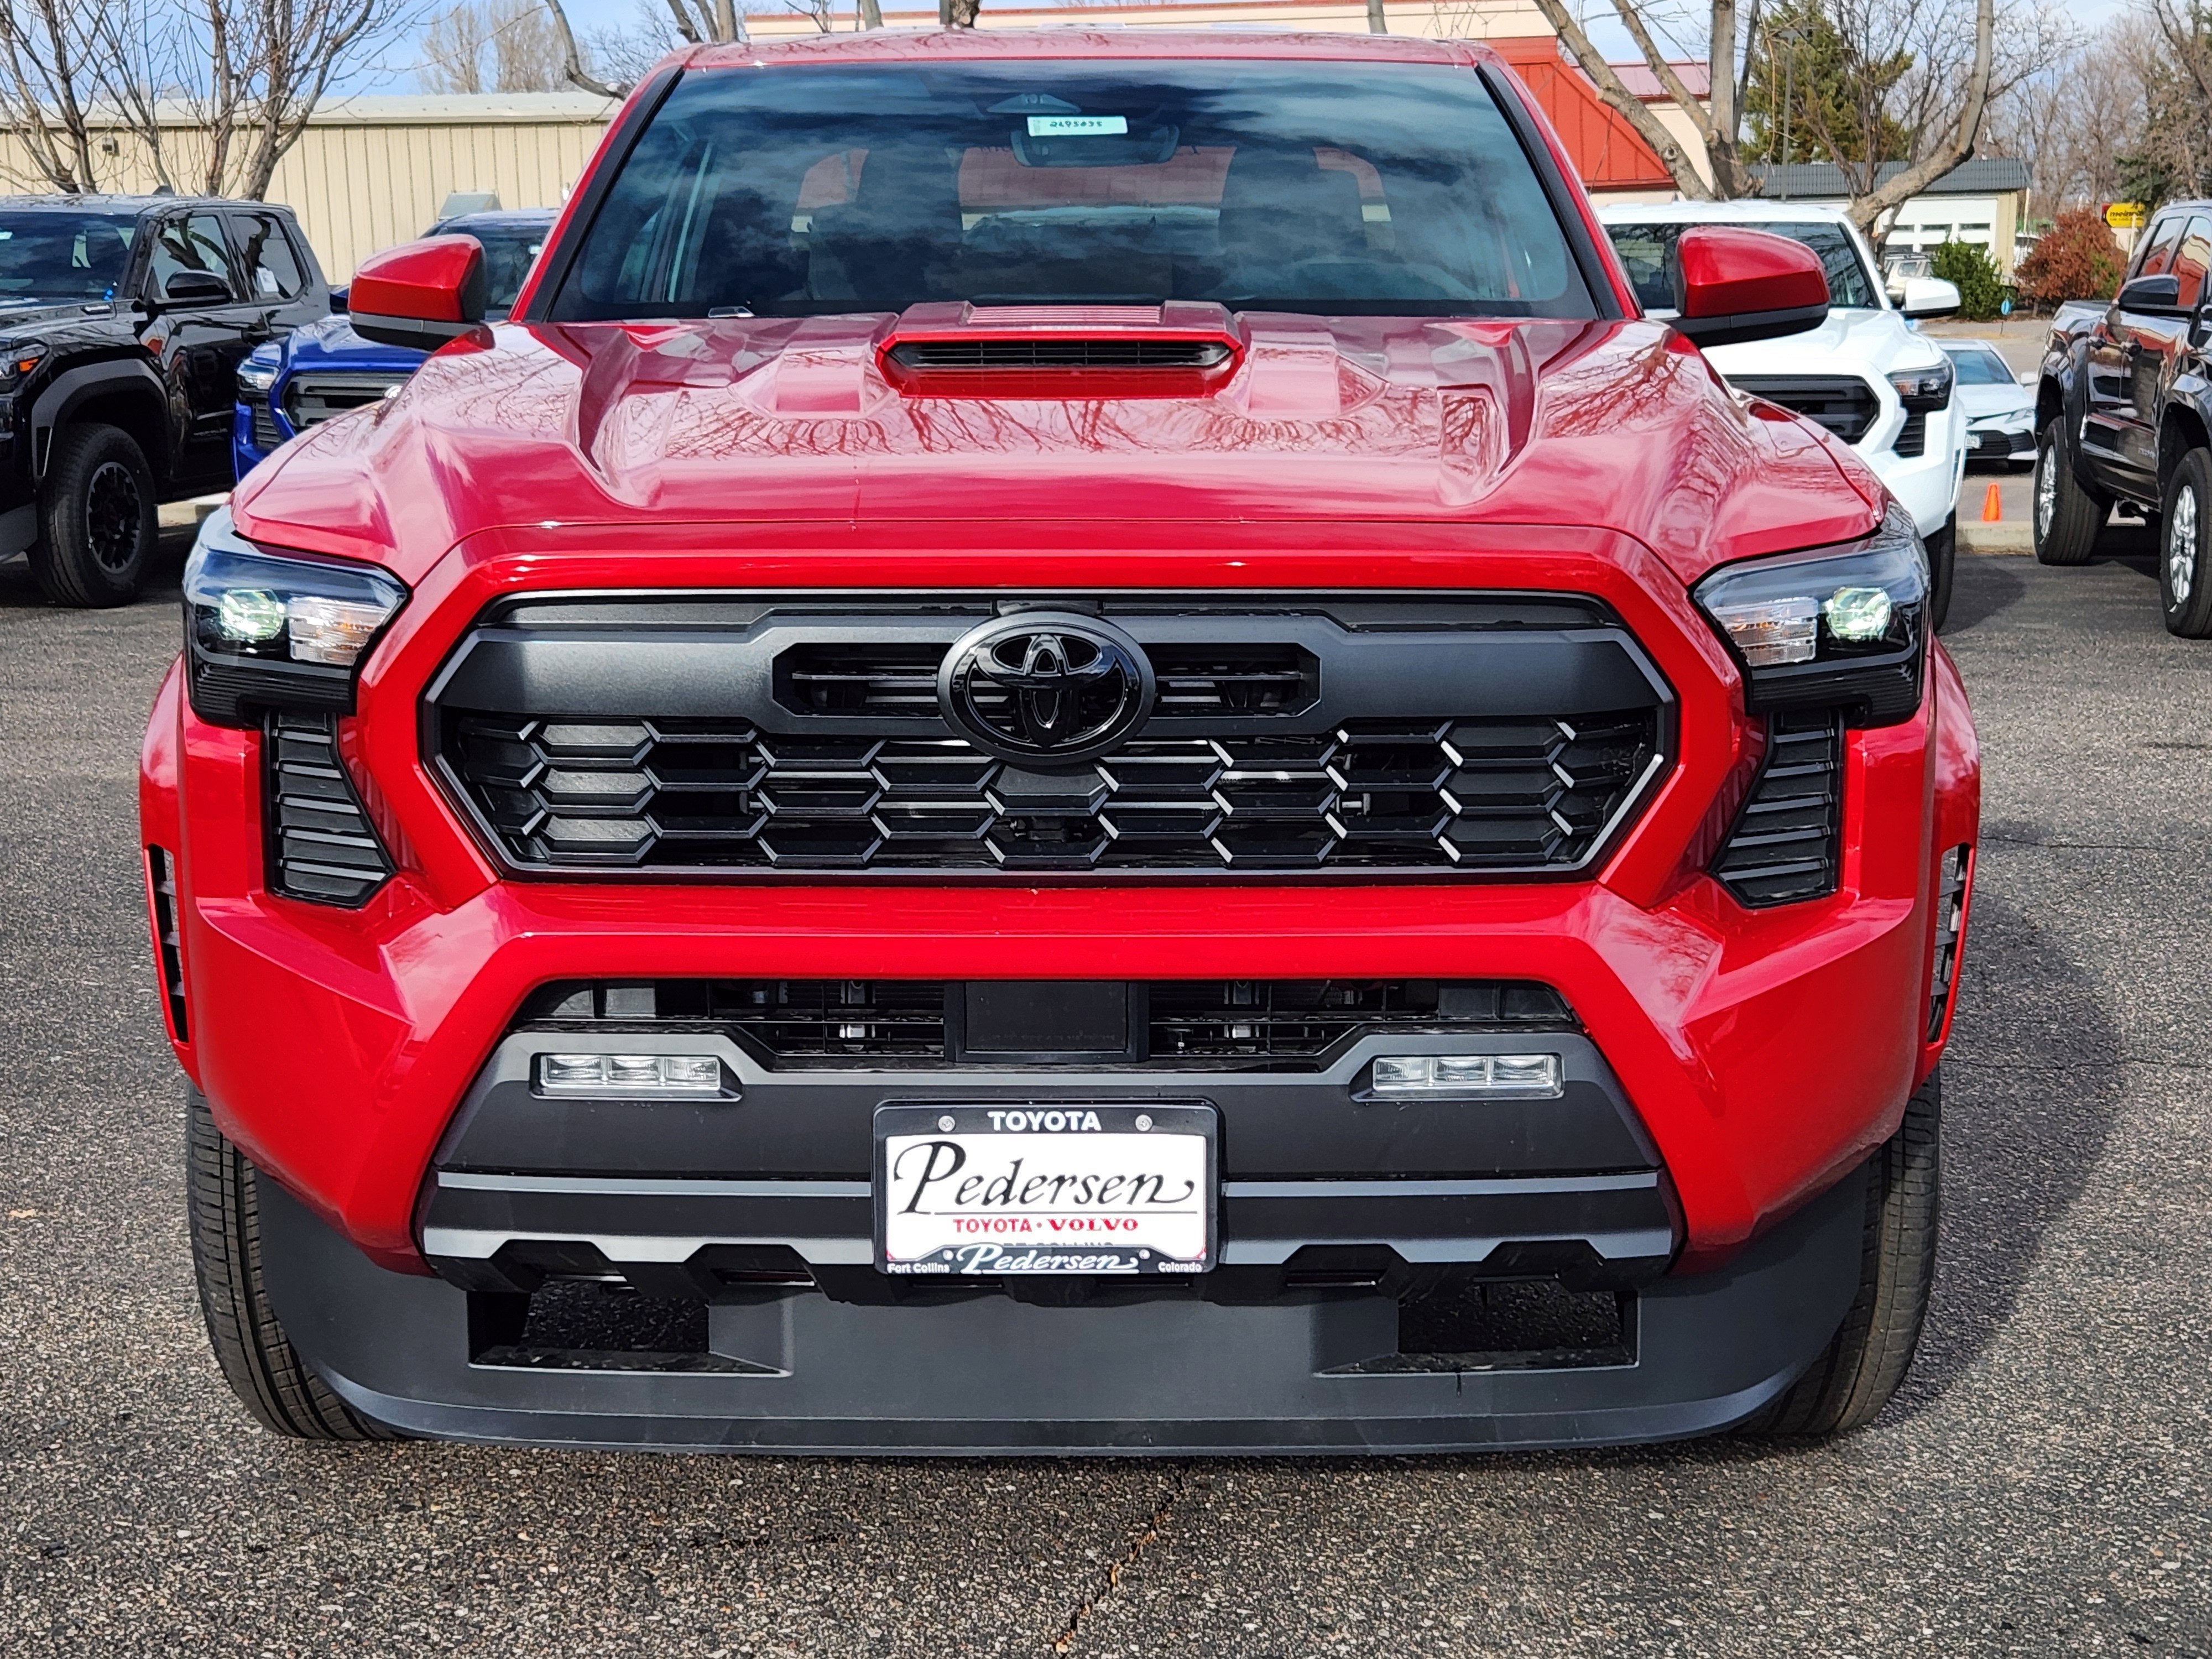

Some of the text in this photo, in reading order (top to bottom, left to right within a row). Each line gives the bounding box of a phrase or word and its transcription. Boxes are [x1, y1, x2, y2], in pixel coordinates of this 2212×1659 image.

[987, 1111, 1102, 1131] TOYOTA
[893, 1141, 1194, 1215] Pedersen
[953, 1218, 1139, 1233] TOYOTA VOLVO
[956, 1243, 1139, 1274] Pedersen
[1157, 1261, 1203, 1273] Colorado
[886, 1262, 950, 1274] Fort Collins
